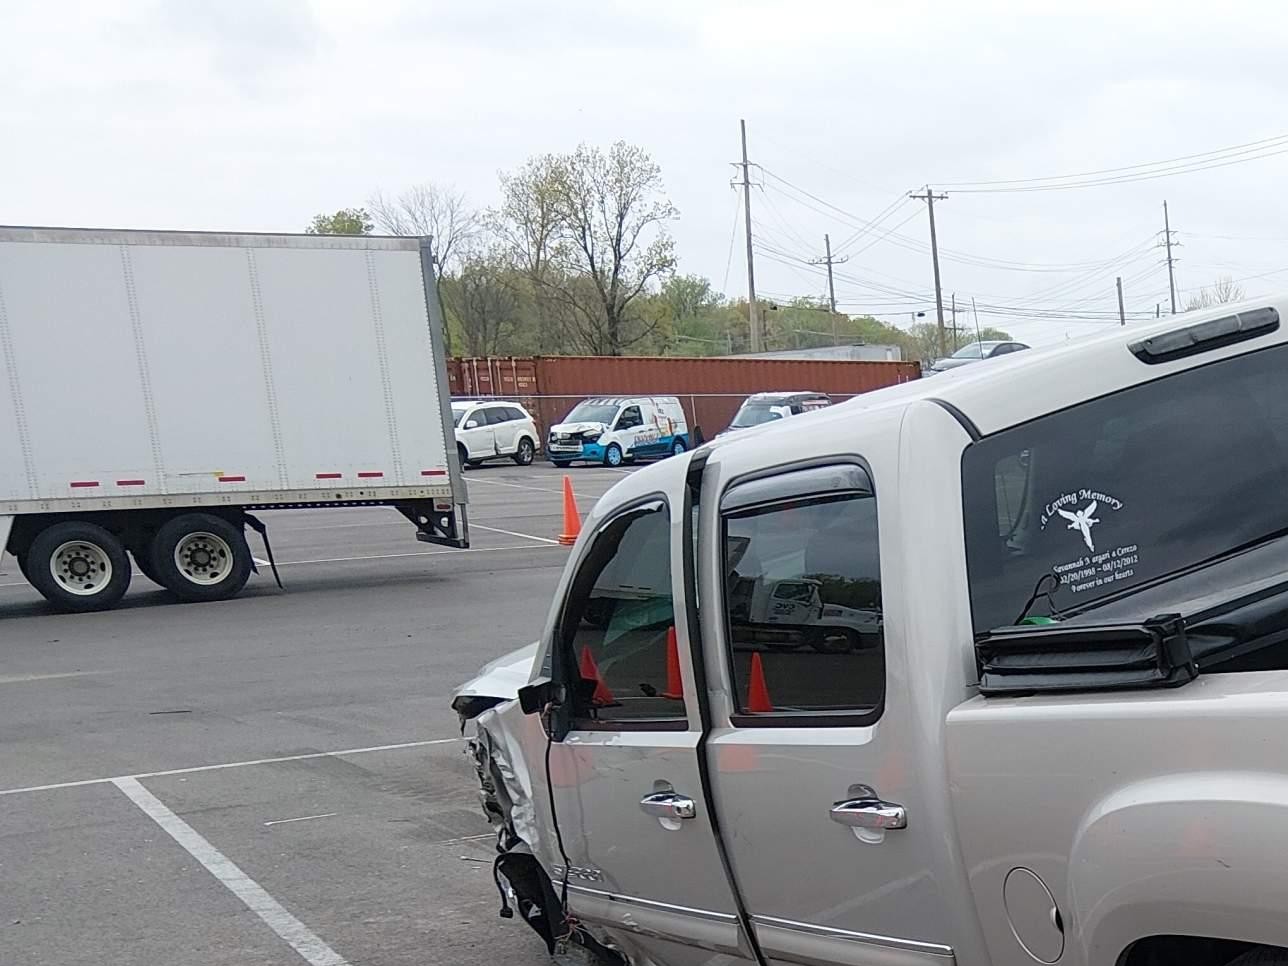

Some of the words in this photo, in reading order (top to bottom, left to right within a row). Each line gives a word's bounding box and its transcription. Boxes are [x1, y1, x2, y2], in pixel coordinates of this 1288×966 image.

[1045, 493, 1078, 516] Loving
[1078, 489, 1123, 510] Memory
[1053, 556, 1084, 573] Savannah
[1103, 574, 1115, 584] our
